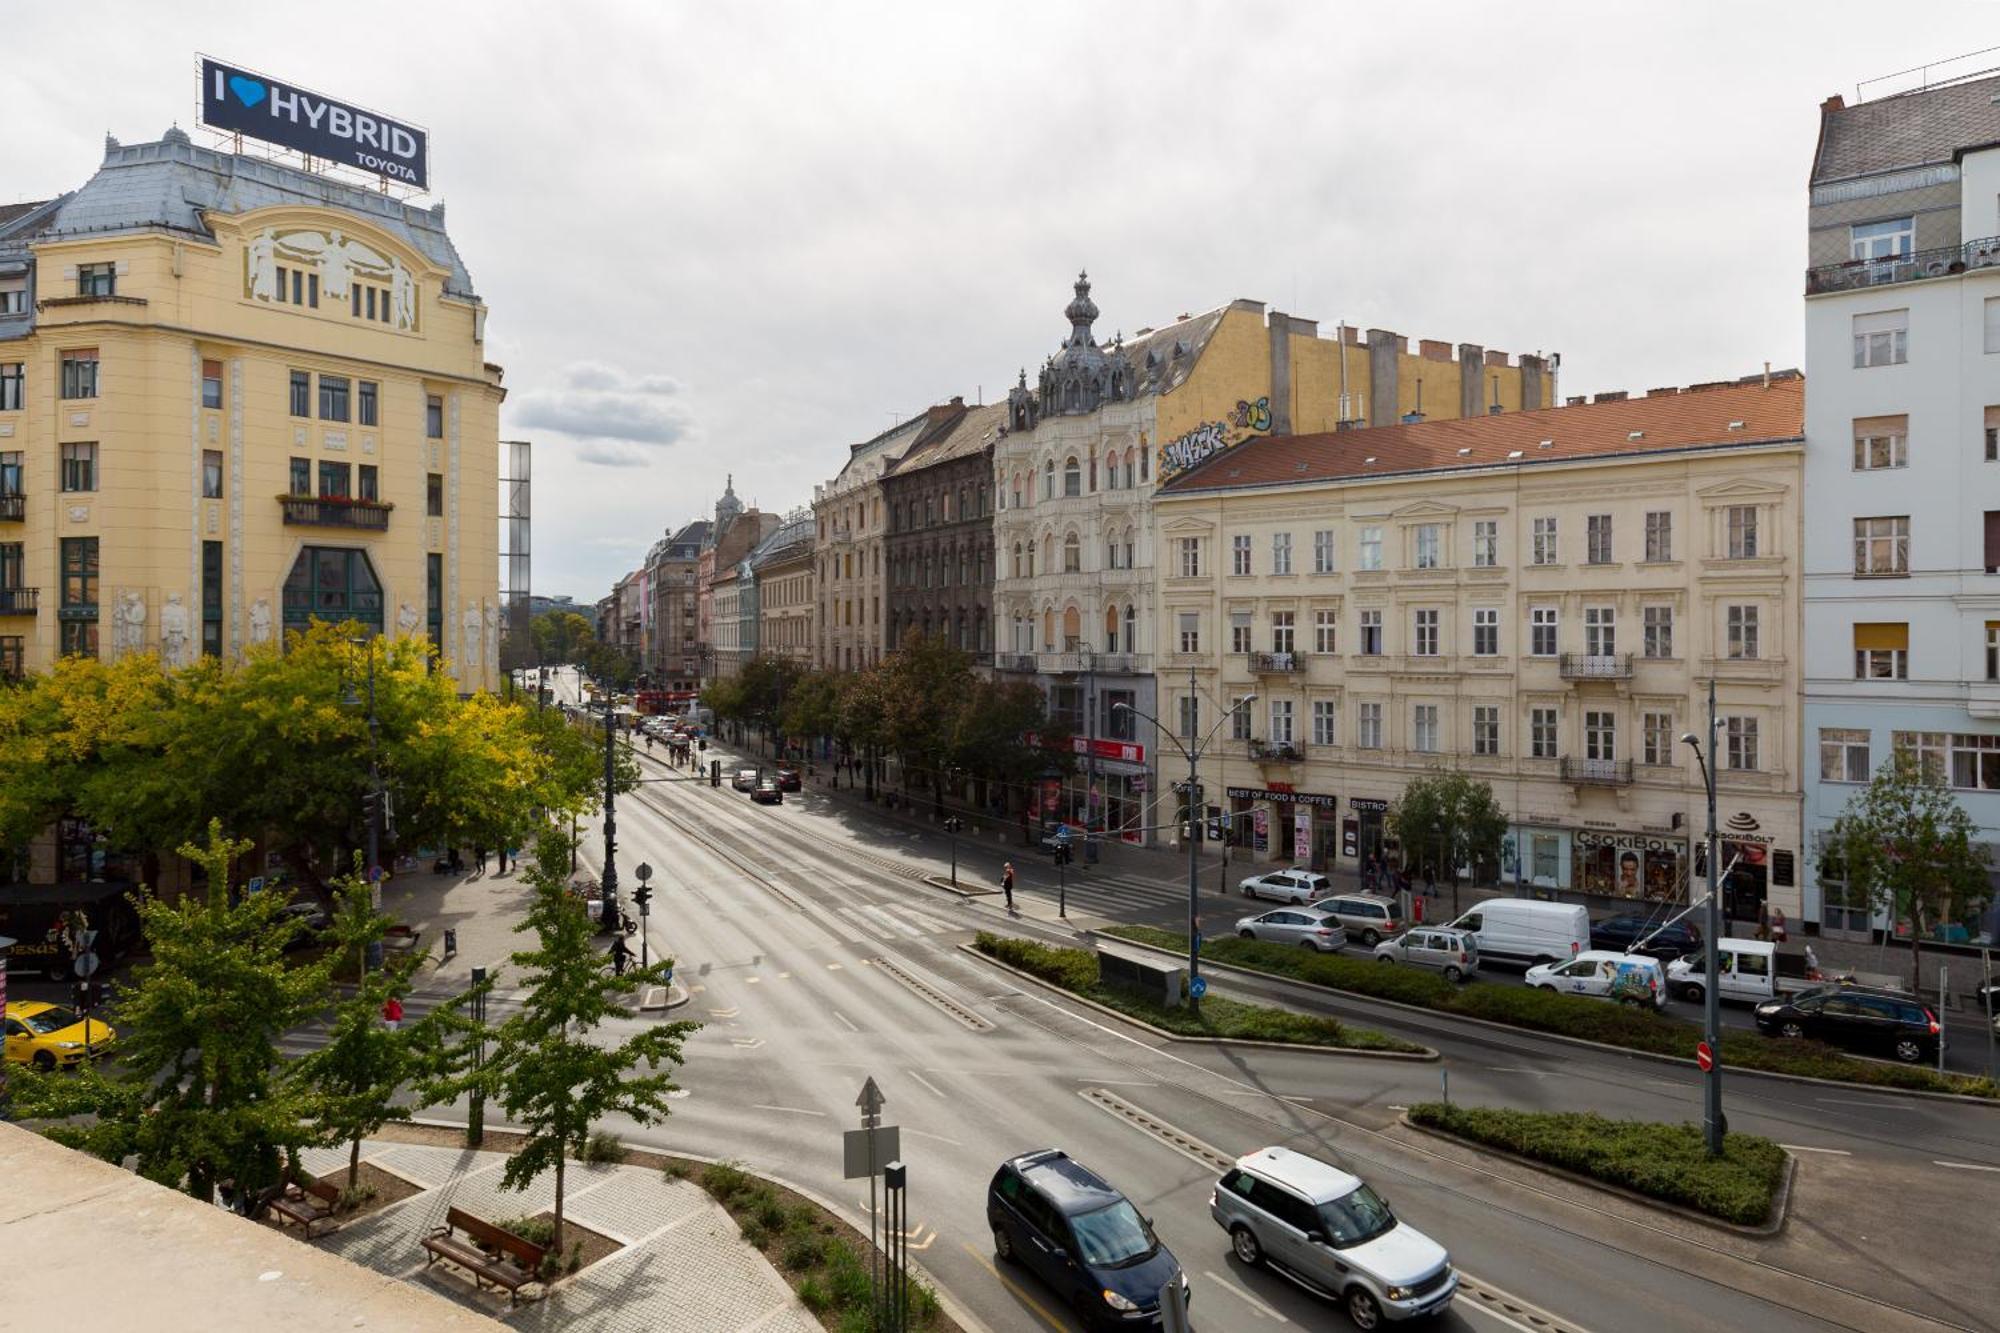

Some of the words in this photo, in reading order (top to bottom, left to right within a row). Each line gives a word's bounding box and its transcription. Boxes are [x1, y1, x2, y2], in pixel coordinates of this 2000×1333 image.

[215, 70, 225, 101] I
[270, 86, 417, 159] HYBRID
[355, 151, 417, 182] TOYOTA
[1228, 789, 1249, 799] BEST
[1251, 791, 1262, 800] OF
[1264, 792, 1289, 802] FOOD
[1298, 795, 1334, 806] COFFEE
